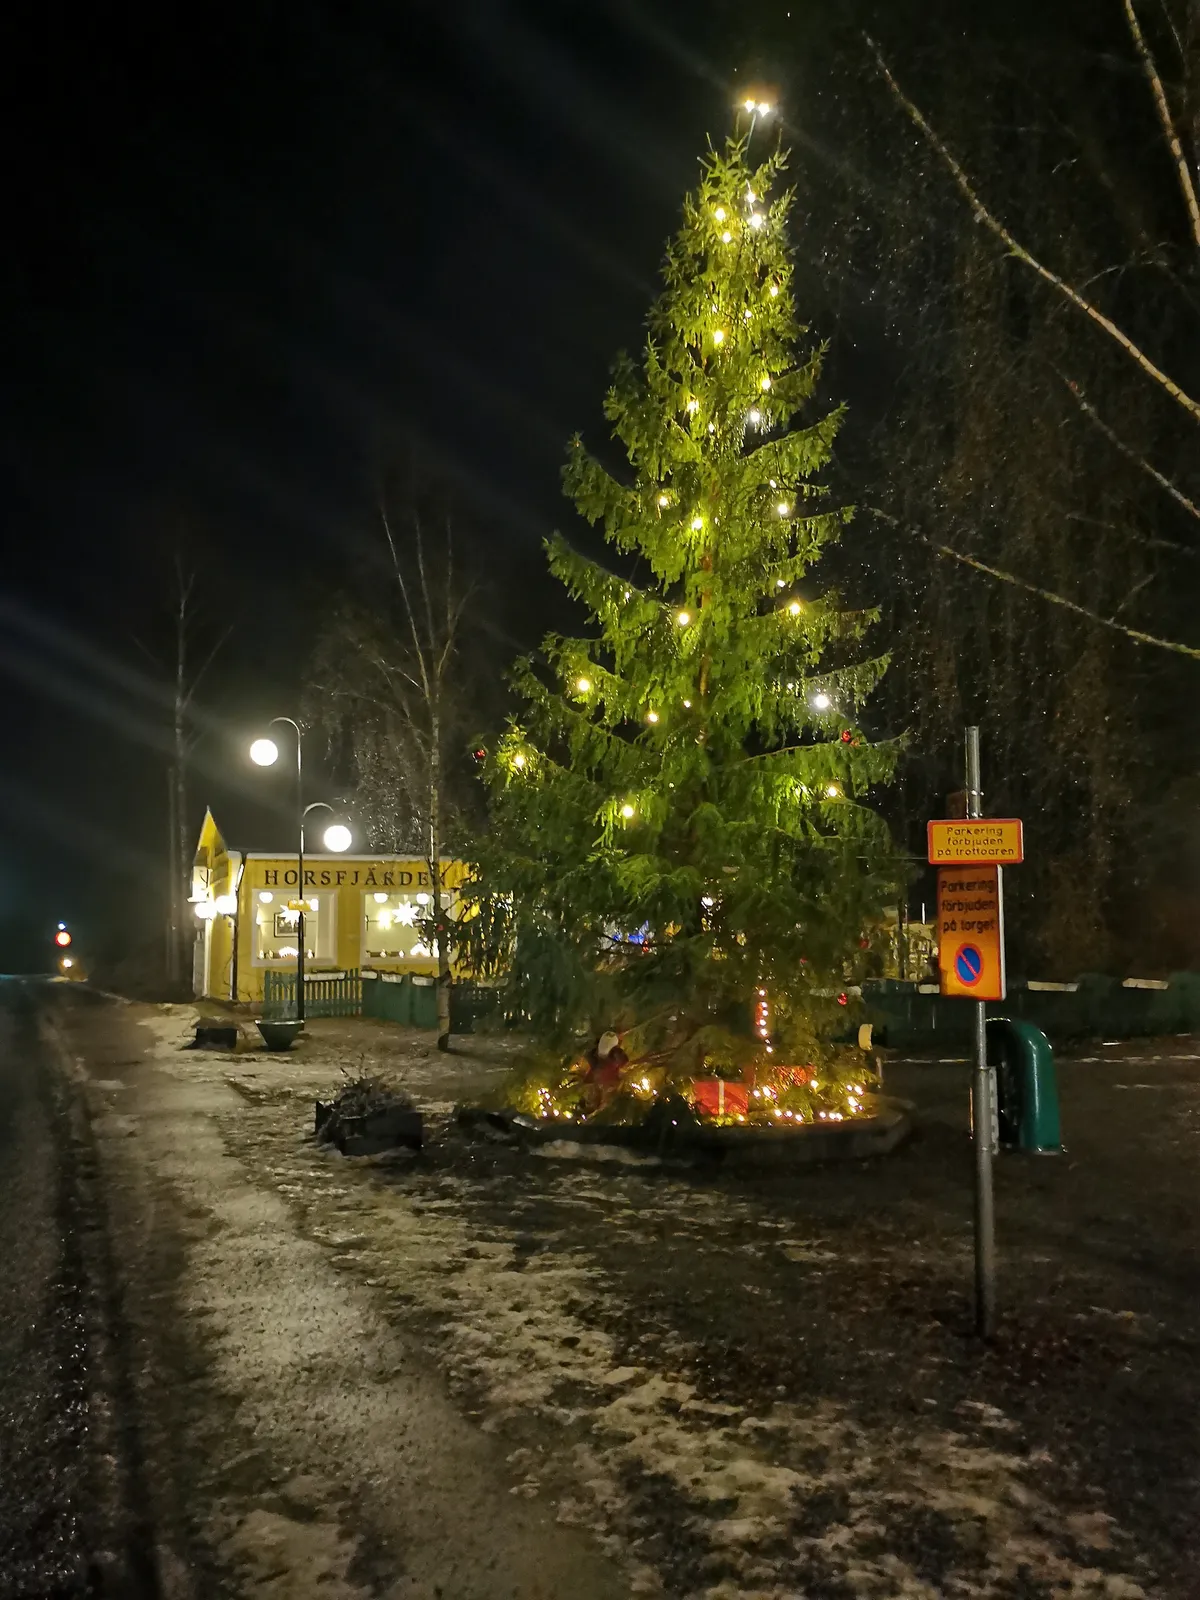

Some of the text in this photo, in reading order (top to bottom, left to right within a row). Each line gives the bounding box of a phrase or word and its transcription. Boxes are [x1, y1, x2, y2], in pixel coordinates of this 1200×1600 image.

[946, 826, 1003, 836] Parkering
[947, 836, 1004, 846] förbjuden
[937, 847, 1015, 858] på trottoaren
[941, 880, 995, 893] Parkering
[942, 899, 996, 914] förbjuden
[943, 918, 996, 934] på torget
